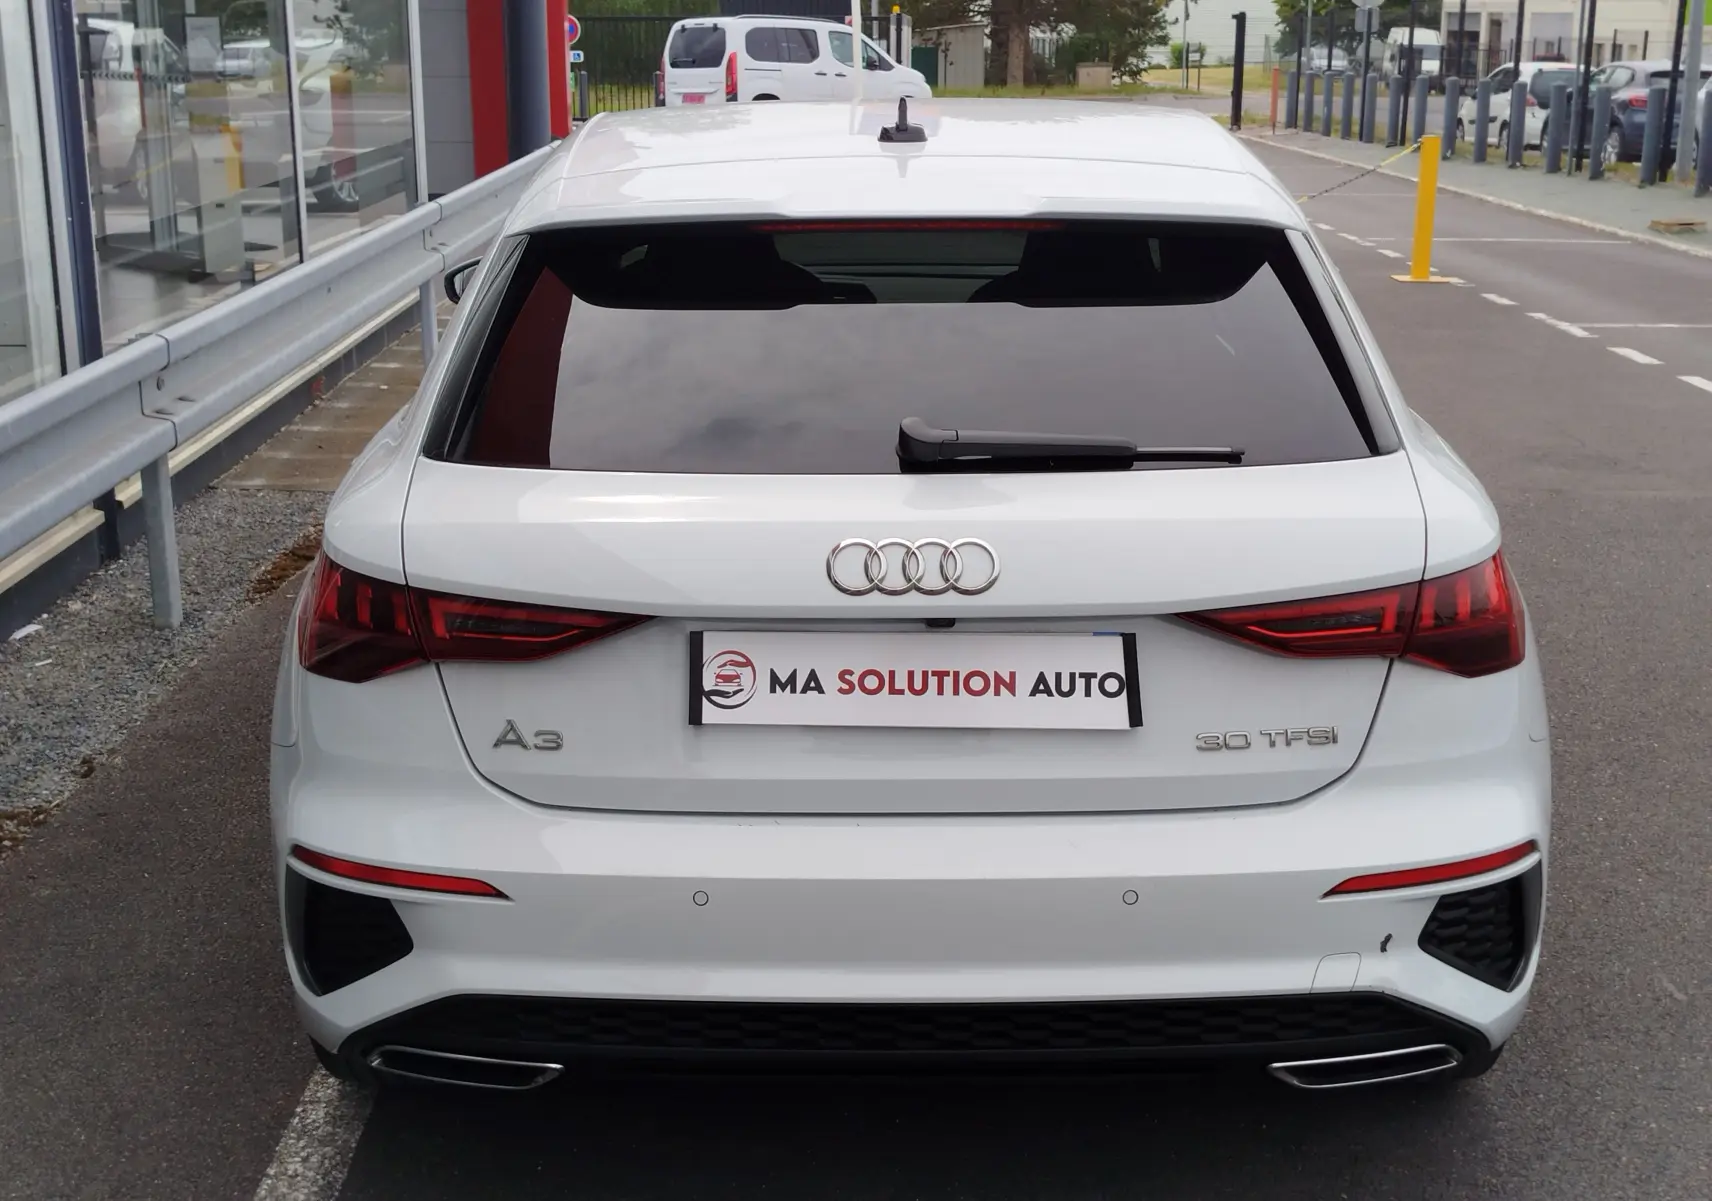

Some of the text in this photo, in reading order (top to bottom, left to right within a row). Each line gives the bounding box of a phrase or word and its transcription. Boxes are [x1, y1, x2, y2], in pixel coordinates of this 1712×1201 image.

[769, 668, 1126, 698] MA SOLUTION AUTO
[492, 718, 564, 751] A3
[1195, 725, 1339, 750] 30 TFSI
